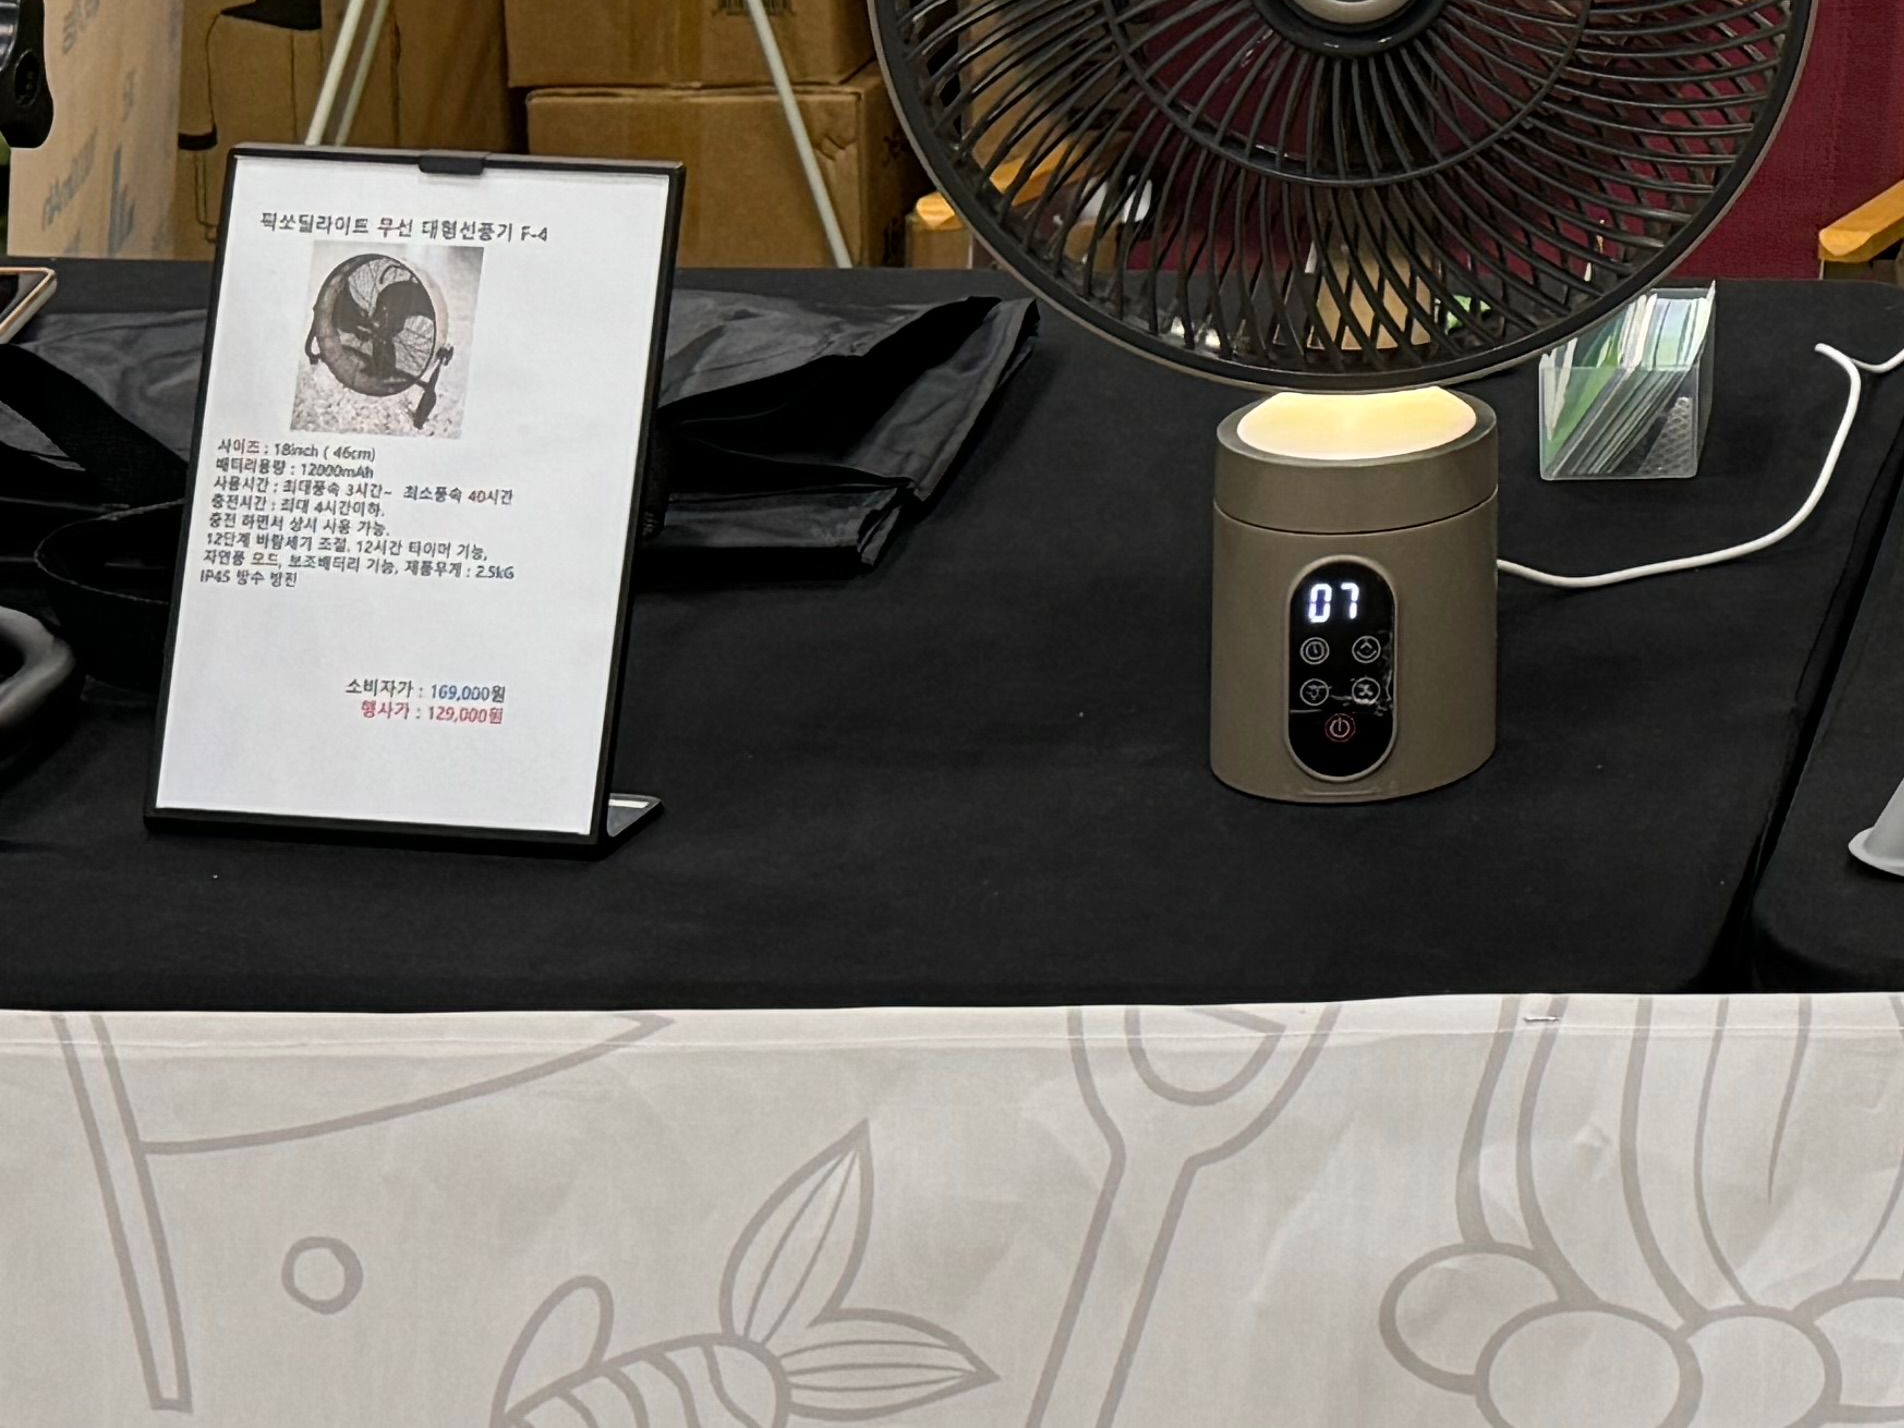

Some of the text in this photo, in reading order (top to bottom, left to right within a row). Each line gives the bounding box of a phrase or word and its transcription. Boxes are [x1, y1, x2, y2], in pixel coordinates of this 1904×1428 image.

[260, 212, 548, 242] 픽쏘딜라이트 무선 대형선풍기 F-4
[218, 438, 318, 457] 사이즈 18inch
[216, 457, 374, 479] 배터리용량 12000mAh
[214, 476, 513, 505] 사용시간 최대풍속 최소풍속 40시간
[211, 494, 267, 511] 충전시간
[280, 498, 310, 514] 최대
[209, 512, 236, 528] 충전
[241, 514, 284, 531] 하면서
[289, 516, 317, 533] 상시
[323, 518, 351, 535] 사용
[207, 532, 250, 548] 12단계
[255, 534, 313, 551] 바람세기
[356, 540, 402, 556] 12시간
[408, 541, 451, 559] 타이머
[203, 549, 245, 566] 자연풍
[288, 554, 361, 573] 보조배터리
[404, 560, 462, 578] 제품무게
[236, 570, 264, 586] 방수
[269, 571, 298, 587] 방진
[1308, 582, 1360, 624] 07
[345, 678, 506, 703] 소비자가 169,000원
[361, 700, 504, 725] 행사가 129,000원
